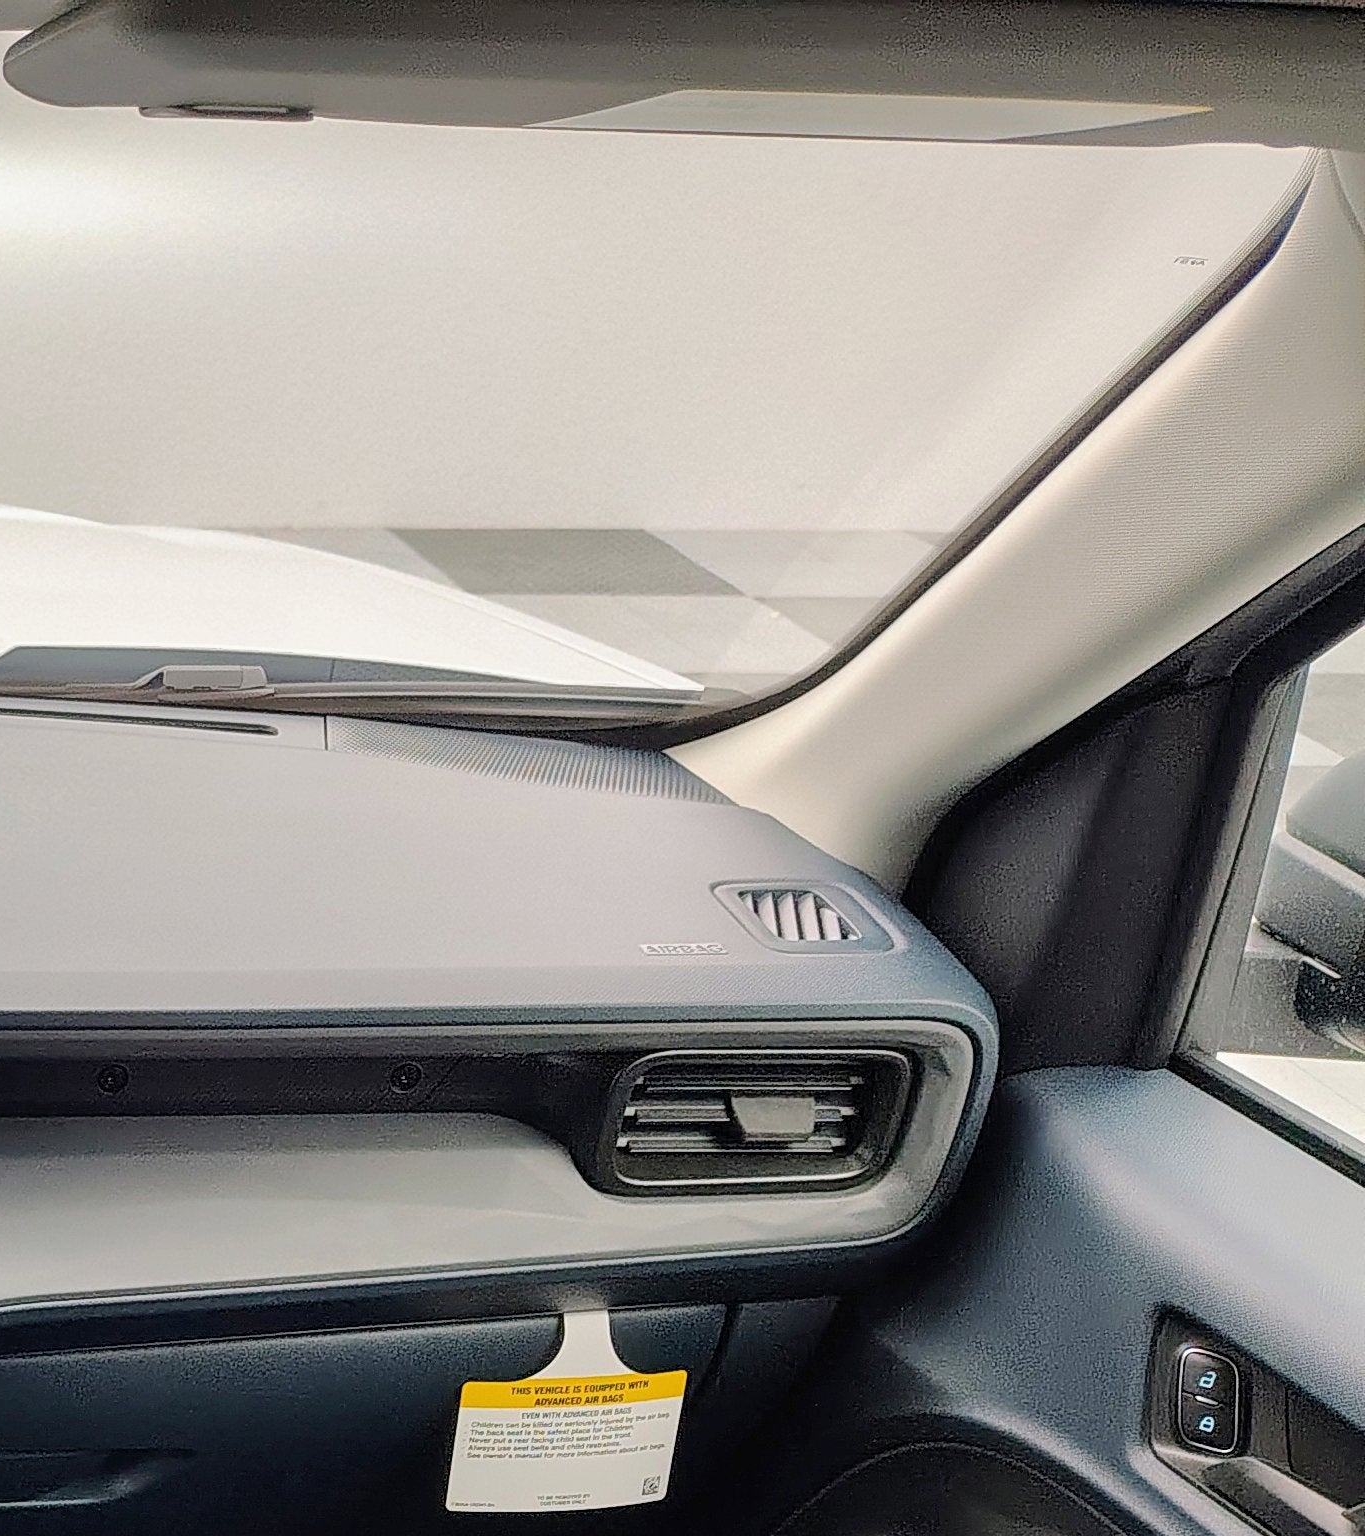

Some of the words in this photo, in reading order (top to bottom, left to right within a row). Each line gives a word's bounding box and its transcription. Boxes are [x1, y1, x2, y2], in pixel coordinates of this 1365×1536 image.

[646, 944, 723, 954] AIRBAG
[511, 1386, 532, 1395] THIS
[534, 1385, 571, 1395] VEHICLE
[573, 1386, 582, 1394] IS
[584, 1383, 626, 1393] EQUIPPED
[628, 1380, 650, 1390] WITH
[534, 1397, 582, 1406] ADVANCED
[584, 1396, 600, 1405] AIR
[602, 1394, 625, 1403] BAGS
[521, 1412, 541, 1420] EVEN
[562, 1410, 599, 1418] ADVANCED
[614, 1407, 633, 1415] BAGS
[564, 1419, 598, 1427] seriously
[600, 1417, 625, 1425] injured
[571, 1426, 591, 1435] place
[492, 1437, 506, 1445] put
[531, 1436, 554, 1445] facing
[543, 1451, 555, 1459] for
[556, 1450, 575, 1458] more
[577, 1449, 617, 1457] information
[618, 1446, 639, 1454] about
